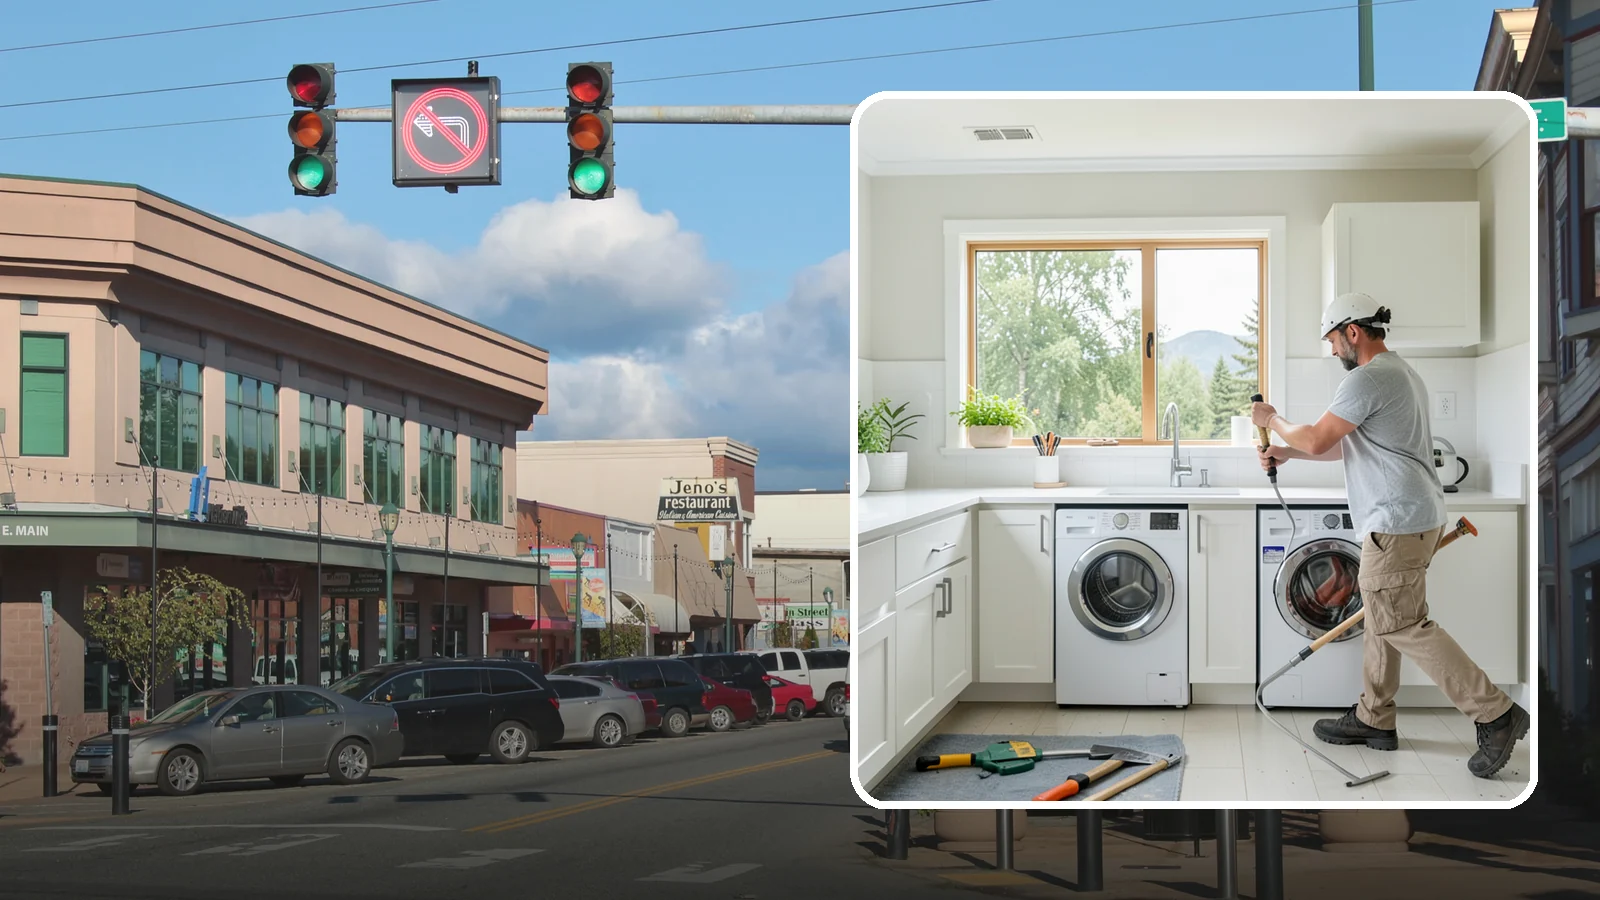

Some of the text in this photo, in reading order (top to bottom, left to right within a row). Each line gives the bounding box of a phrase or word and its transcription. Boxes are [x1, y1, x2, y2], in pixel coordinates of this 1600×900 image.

[669, 480, 728, 495] Jeno's
[665, 496, 731, 509] restaurant
[658, 510, 681, 520] Italian
[686, 510, 714, 519] American
[715, 510, 738, 519] Cuisine
[2, 525, 49, 536] E. MAIN
[797, 607, 828, 617] Street
